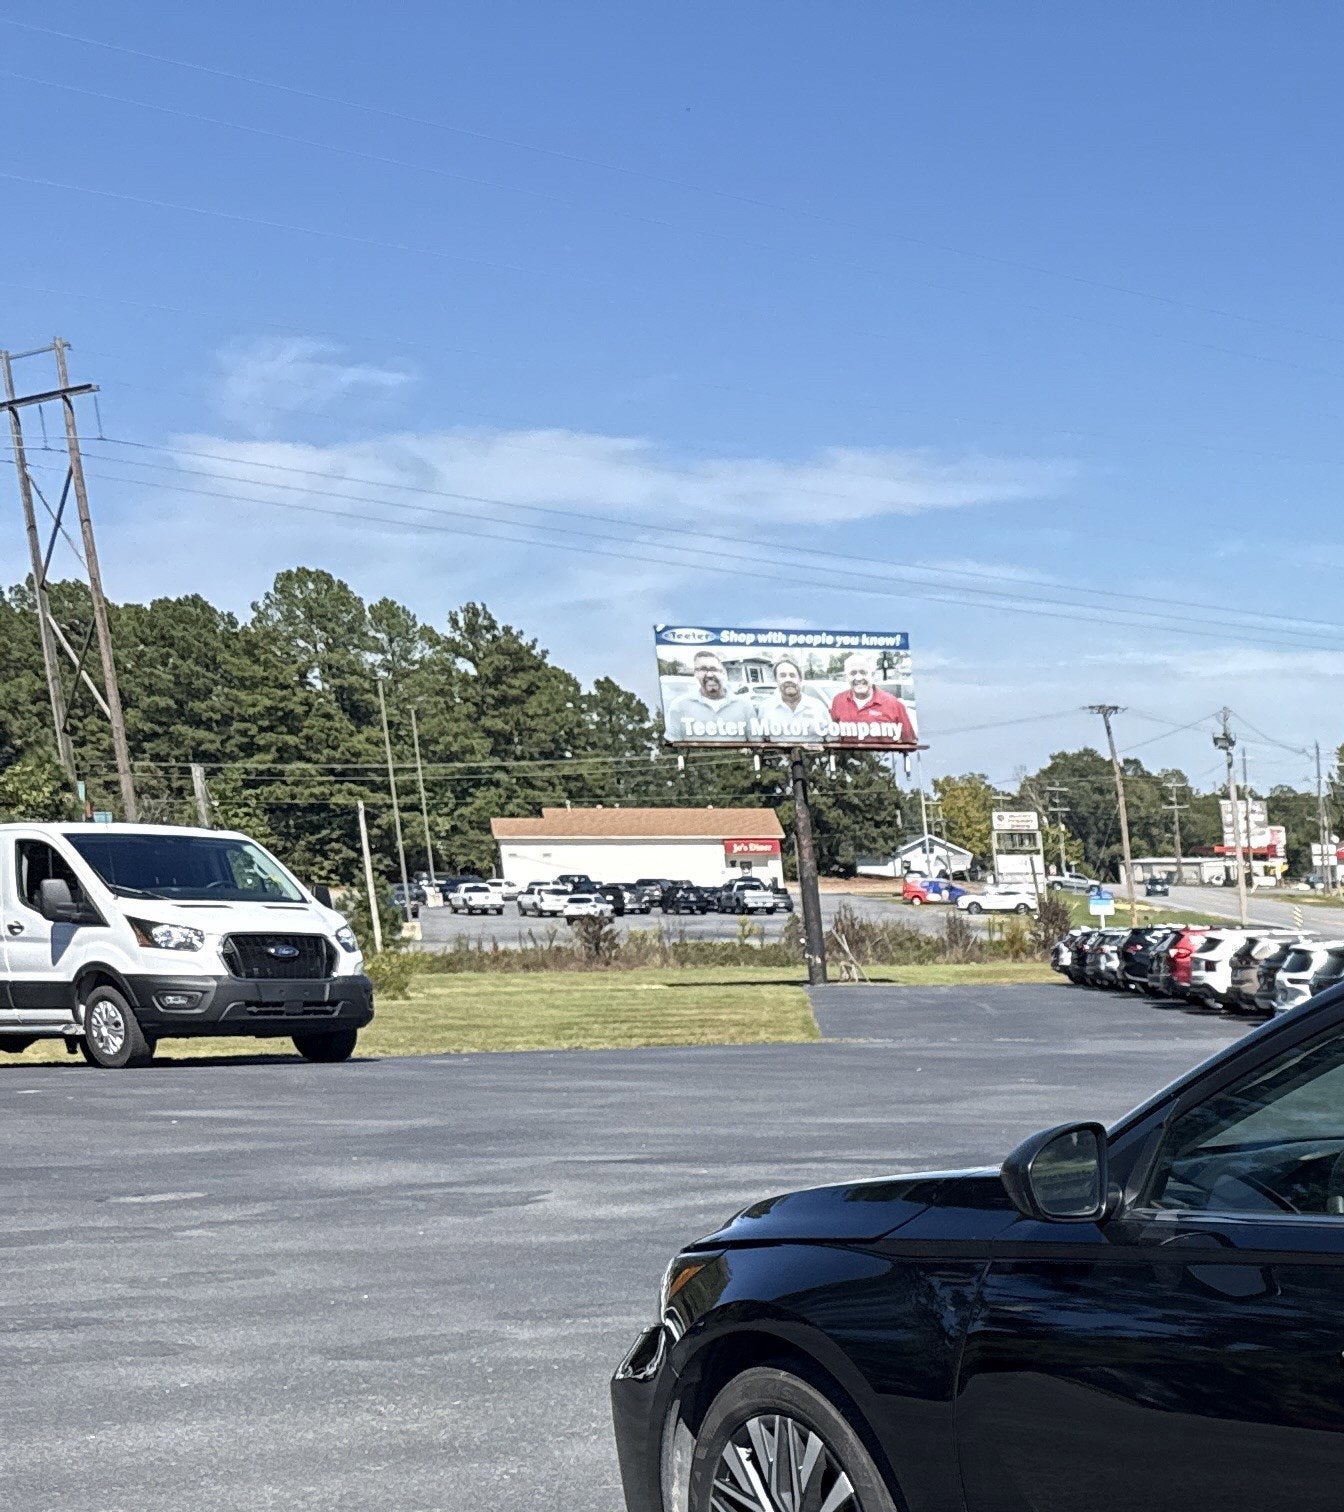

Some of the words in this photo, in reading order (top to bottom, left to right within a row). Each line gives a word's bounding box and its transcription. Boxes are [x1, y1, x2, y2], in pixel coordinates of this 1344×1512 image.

[669, 630, 710, 641] Teeter
[720, 630, 755, 644] Shop
[757, 631, 786, 644] with
[789, 633, 833, 647] people
[836, 635, 859, 647] you
[861, 633, 901, 646] know!
[681, 717, 747, 736] Teeter
[750, 718, 810, 736] Motor
[815, 720, 902, 741] Company
